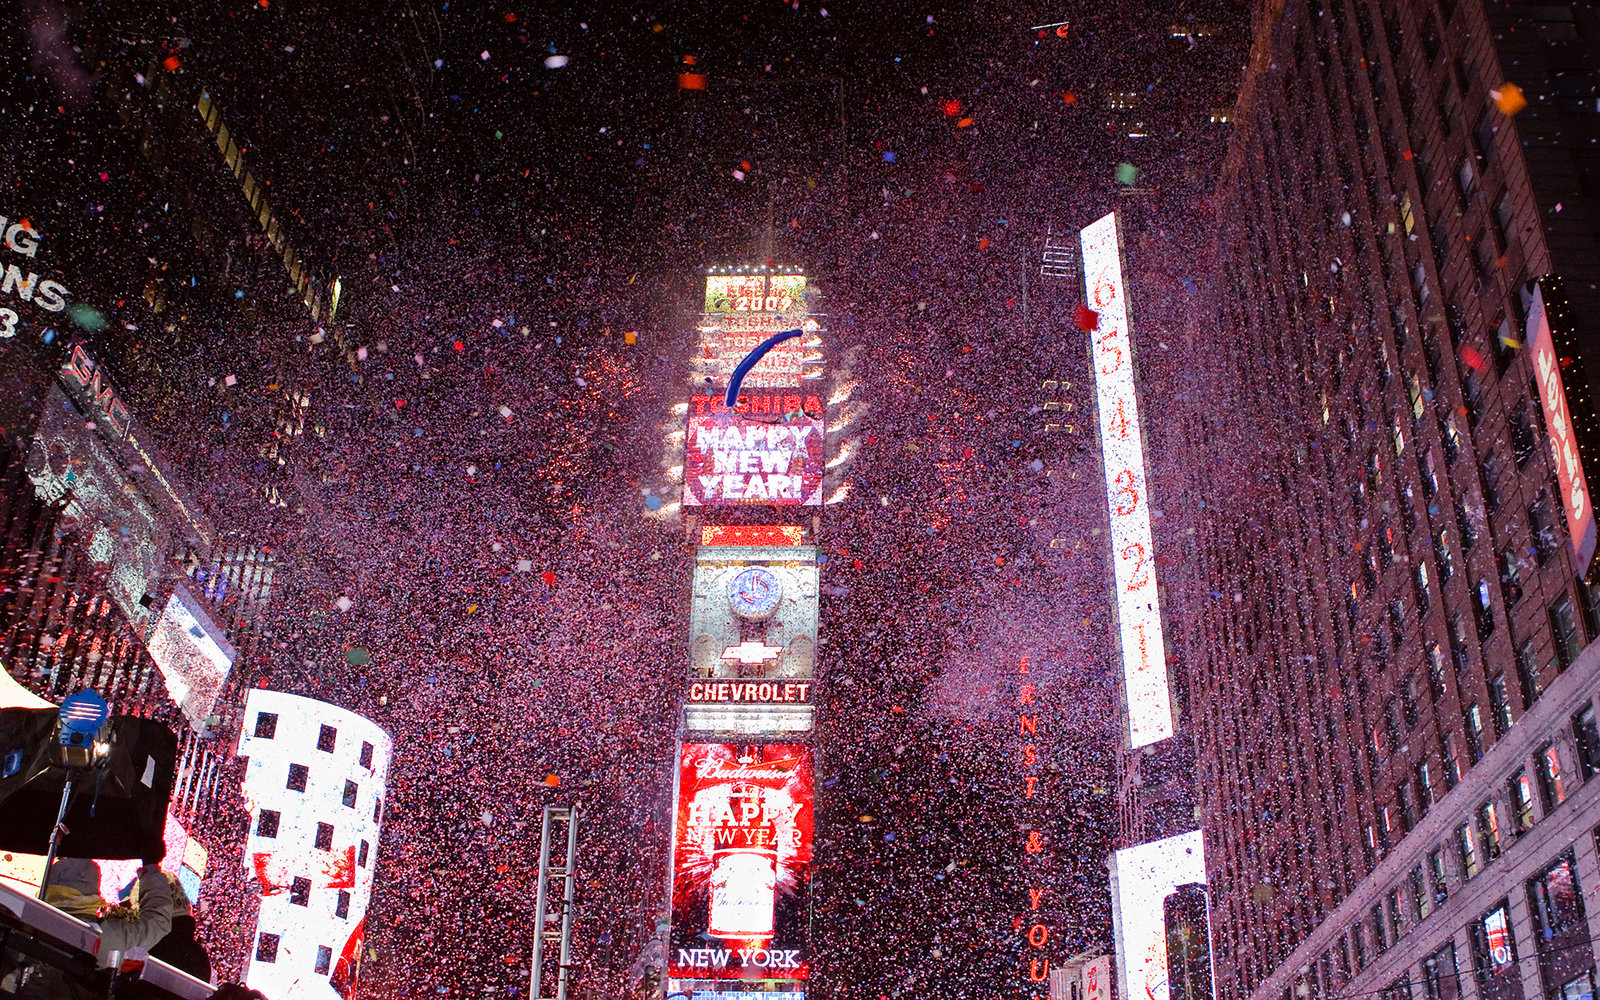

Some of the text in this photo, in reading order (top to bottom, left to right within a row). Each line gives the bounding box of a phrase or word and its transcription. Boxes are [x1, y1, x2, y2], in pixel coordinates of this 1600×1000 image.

[0, 262, 69, 312] NS
[71, 345, 128, 437] GMC
[691, 394, 823, 414] TOSHIBA
[696, 425, 813, 455] HAPPY
[712, 450, 793, 474] NEW
[697, 475, 803, 499] YEAR!
[690, 683, 809, 701] CHEVROLET
[1019, 655, 1038, 798] ERNST
[694, 757, 797, 779] Budweiser
[686, 802, 803, 827] HAPPY
[686, 828, 803, 848] NEW YEAR
[1028, 888, 1050, 1000] YOU
[677, 949, 800, 968] NEW YORK
